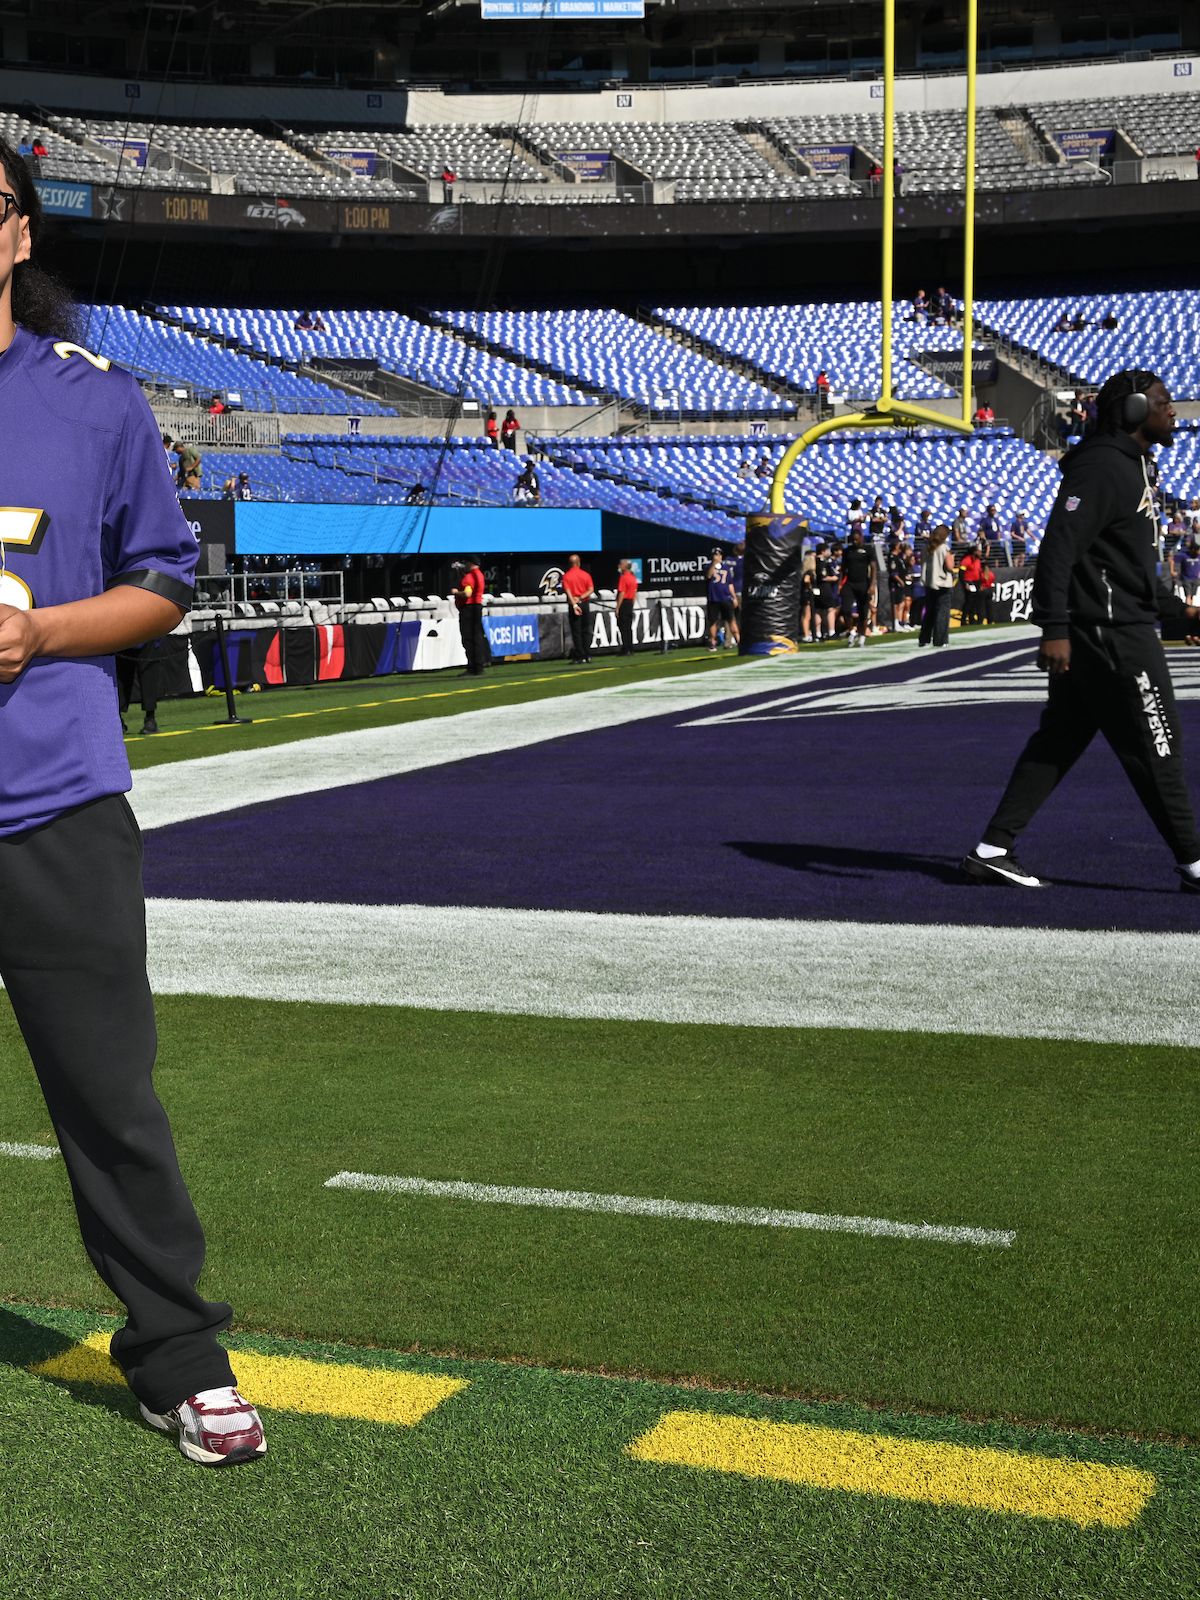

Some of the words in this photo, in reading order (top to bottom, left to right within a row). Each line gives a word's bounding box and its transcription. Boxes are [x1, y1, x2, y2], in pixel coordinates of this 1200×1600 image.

[165, 198, 187, 220] 1:00
[191, 200, 209, 221] PM
[345, 207, 368, 228] 1:00
[371, 207, 390, 229] PM
[925, 360, 992, 373] PROGRESIVE
[713, 569, 728, 584] 57
[1134, 670, 1171, 757] RAVENS
